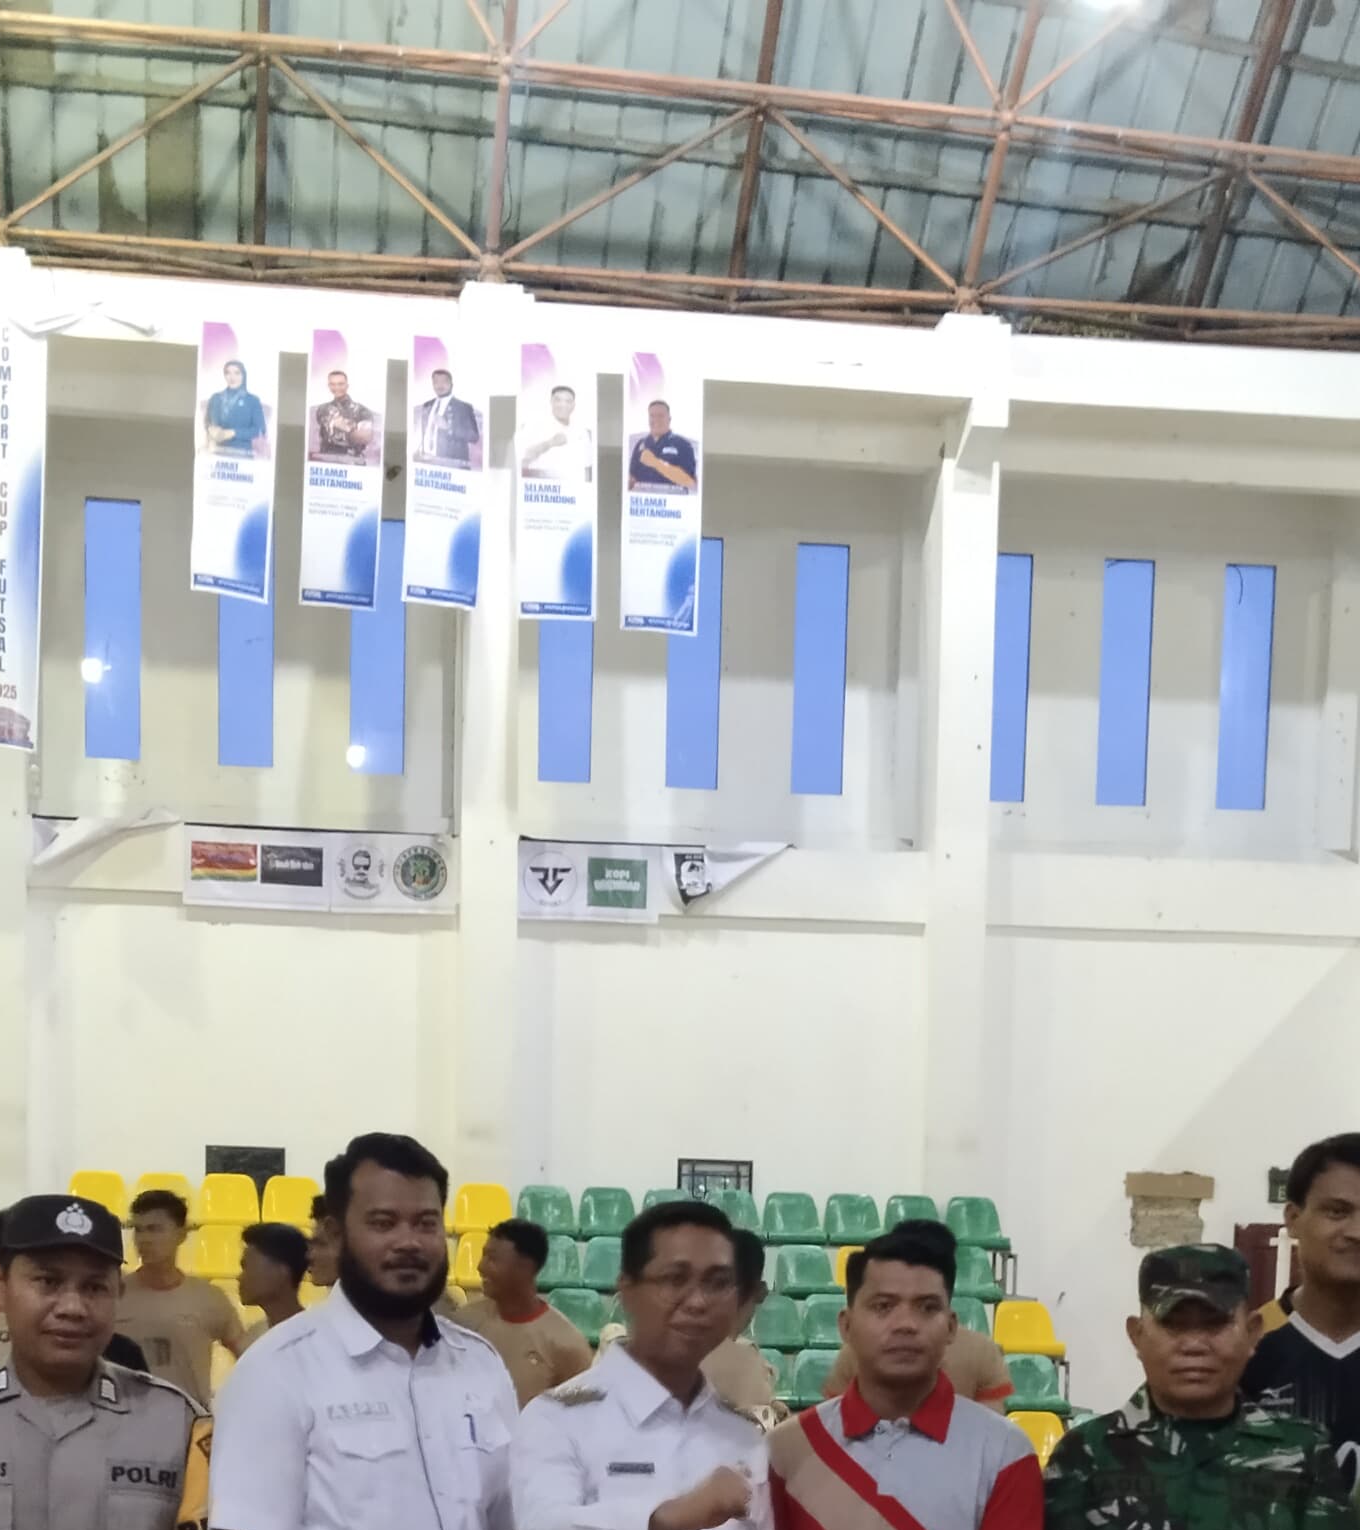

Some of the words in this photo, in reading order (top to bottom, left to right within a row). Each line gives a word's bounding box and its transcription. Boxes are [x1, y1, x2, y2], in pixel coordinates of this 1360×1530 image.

[310, 466, 348, 477] SELAMAT
[414, 468, 452, 481] SELAMAT
[309, 477, 362, 490] BERTANDING
[414, 478, 466, 494] BERTANDING
[524, 483, 561, 494] SELAMAT
[523, 493, 576, 504] BERTANDING
[630, 496, 667, 507] SELAMAT
[0, 481, 8, 537] CUP
[629, 507, 682, 519] BERTANDING
[111, 1466, 178, 1488] POLRI
